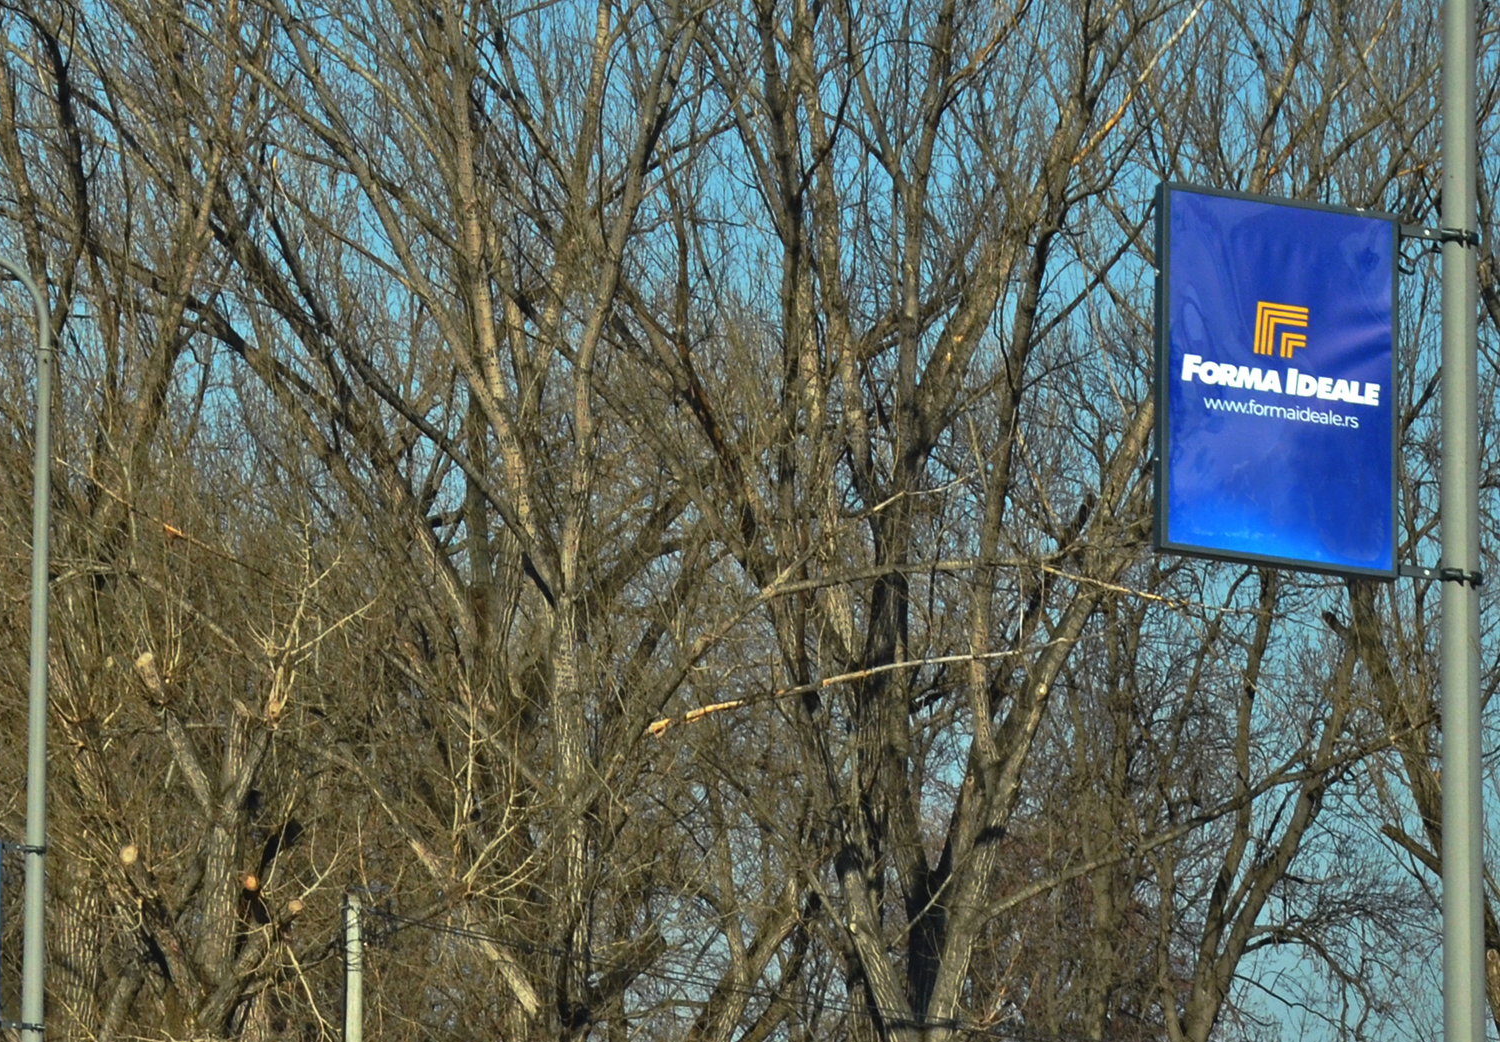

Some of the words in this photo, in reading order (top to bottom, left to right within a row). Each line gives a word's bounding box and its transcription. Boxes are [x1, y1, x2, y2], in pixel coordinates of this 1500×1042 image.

[1181, 354, 1283, 393] FORMA
[1285, 368, 1380, 406] IDEALE
[1203, 397, 1359, 429] www.formaideale.rs
